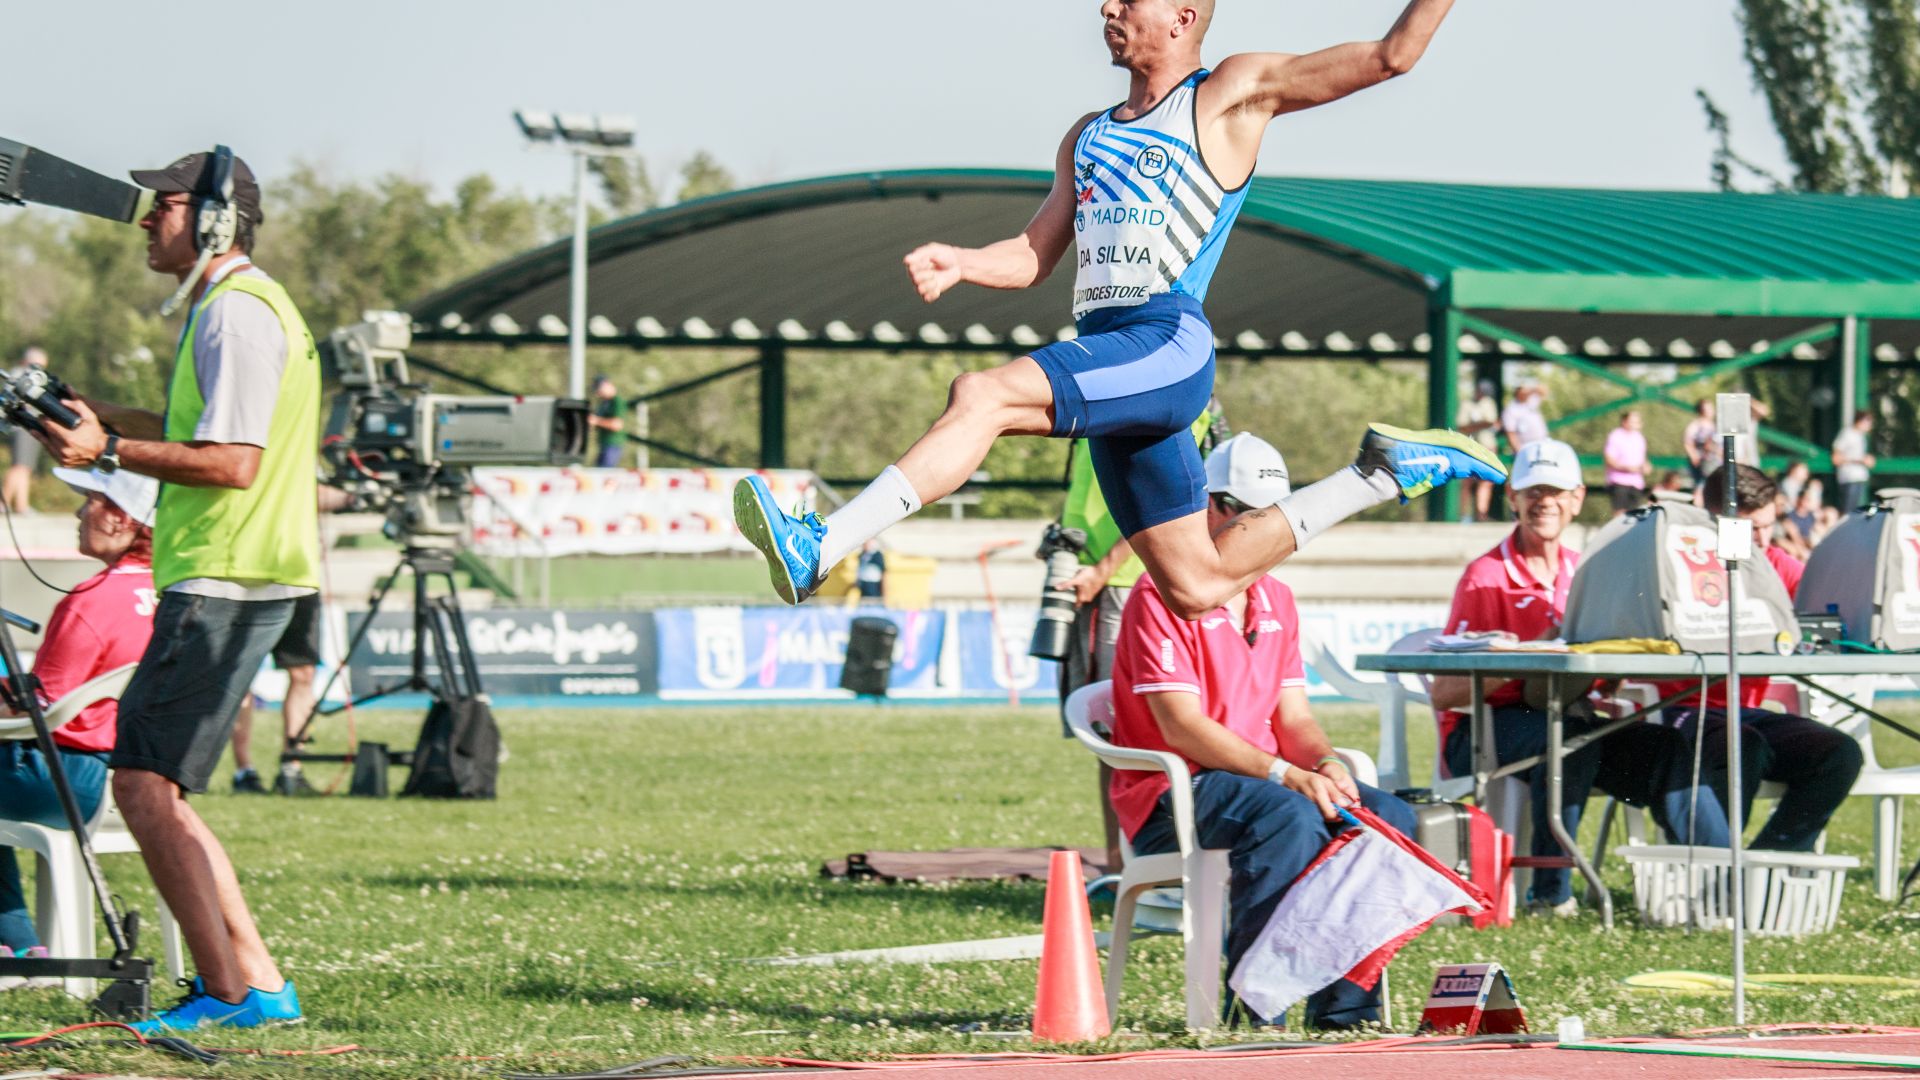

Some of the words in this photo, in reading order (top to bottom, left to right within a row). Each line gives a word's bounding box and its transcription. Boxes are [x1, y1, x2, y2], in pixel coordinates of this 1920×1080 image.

[1090, 207, 1165, 226] MADRID
[1080, 250, 1092, 269] DA
[1096, 245, 1152, 265] SILVA
[1075, 285, 1149, 305] BRIDGESTONE
